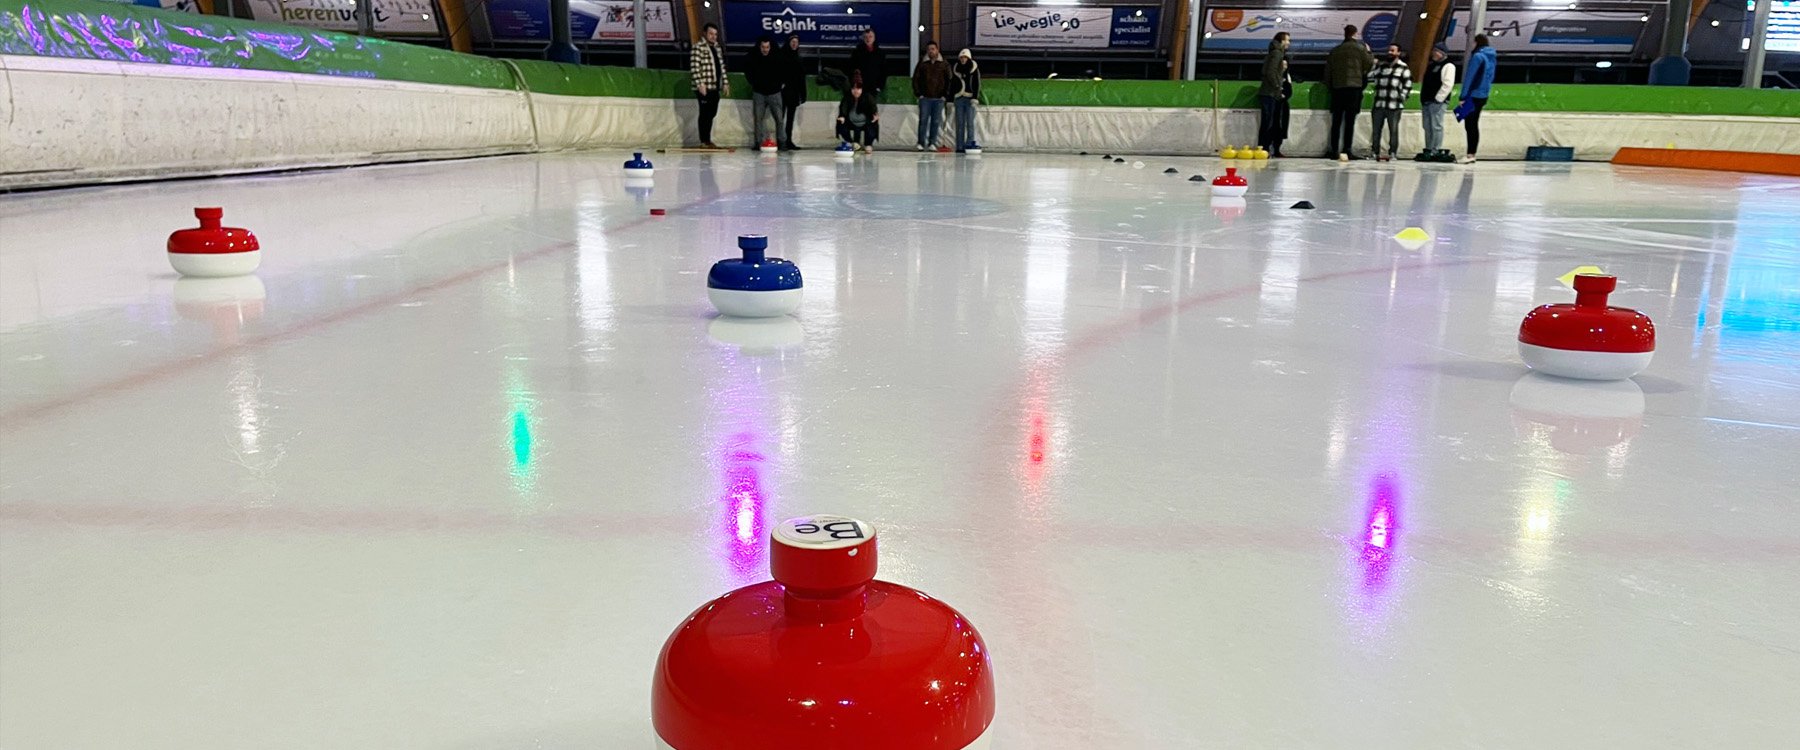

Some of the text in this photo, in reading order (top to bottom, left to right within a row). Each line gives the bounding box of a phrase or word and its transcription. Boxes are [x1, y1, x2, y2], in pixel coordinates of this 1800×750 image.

[762, 17, 817, 34] Eggink
[994, 14, 1016, 29] Lie
[1060, 17, 1080, 32] 20
[1114, 26, 1151, 35] specialist
[795, 521, 864, 538] Be
